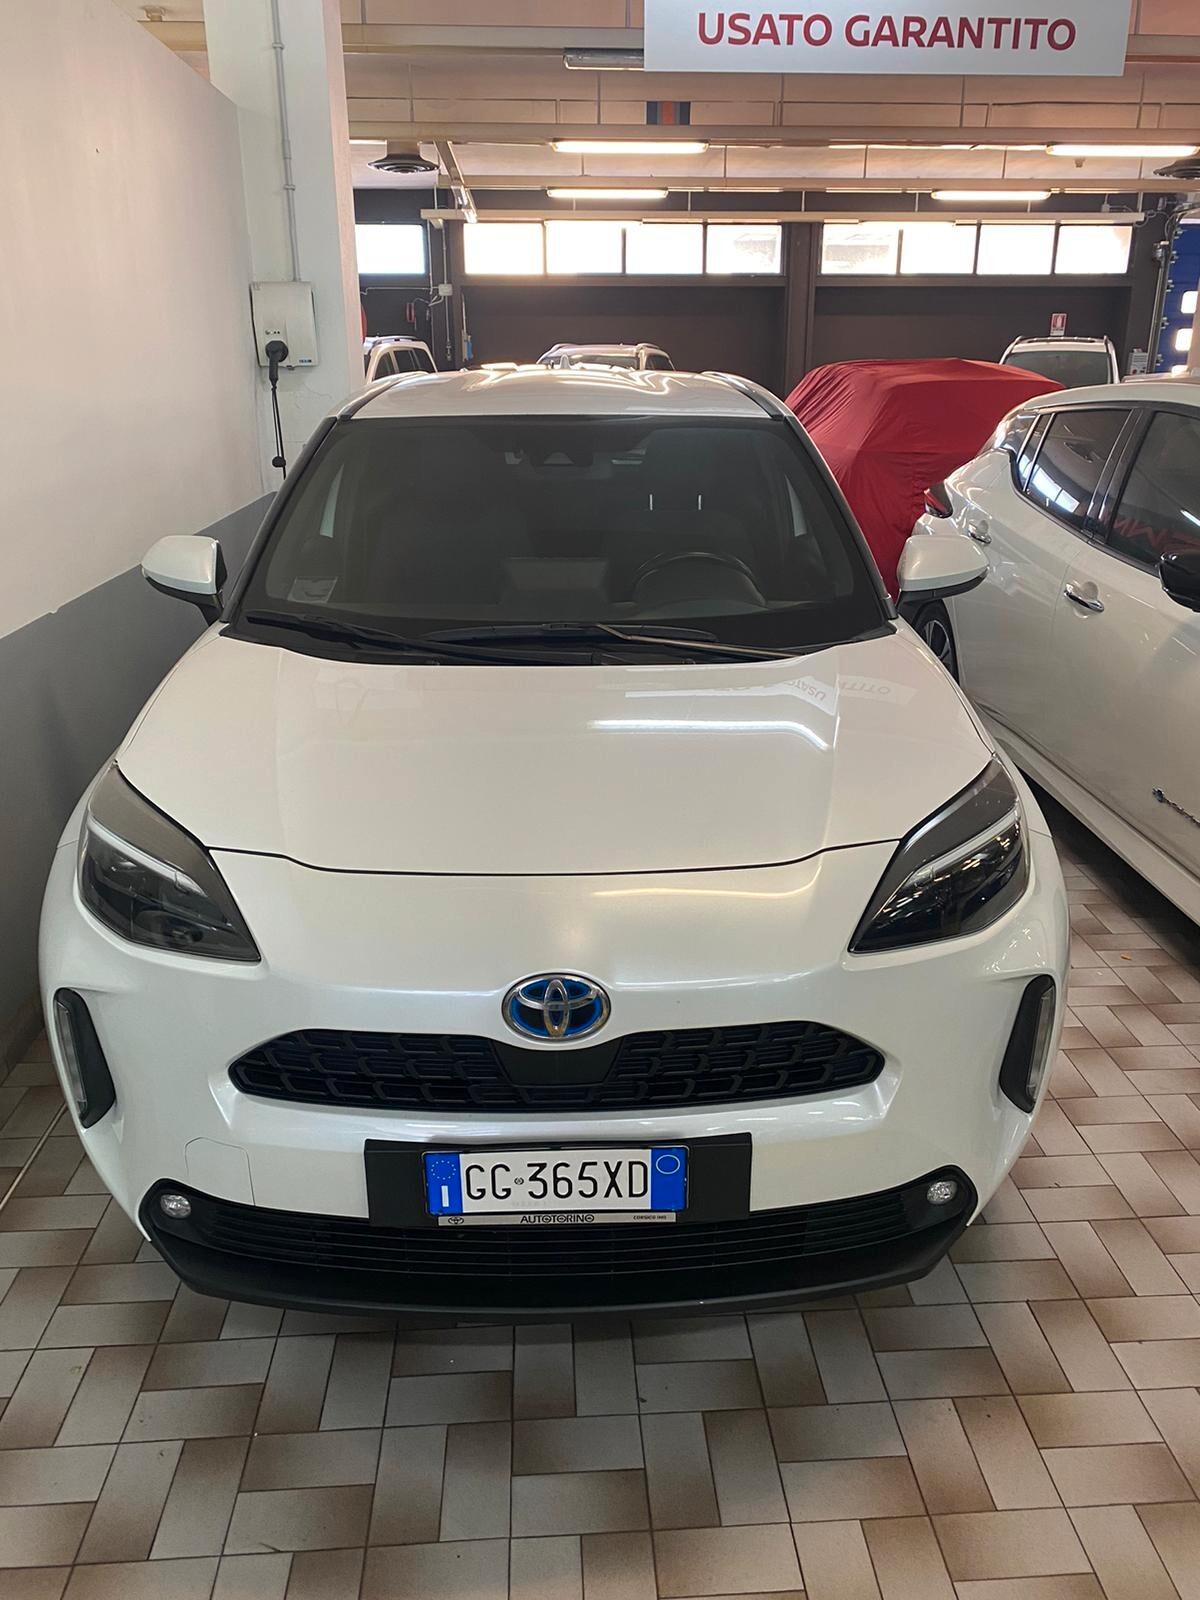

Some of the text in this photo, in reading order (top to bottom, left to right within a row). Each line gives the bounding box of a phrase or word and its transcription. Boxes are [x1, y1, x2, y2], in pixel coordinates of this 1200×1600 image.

[698, 12, 1077, 51] USATO GARANTITO
[465, 1160, 648, 1200] GG 365XD
[441, 1185, 450, 1207] I
[520, 1214, 595, 1224] AUTOTORINO
